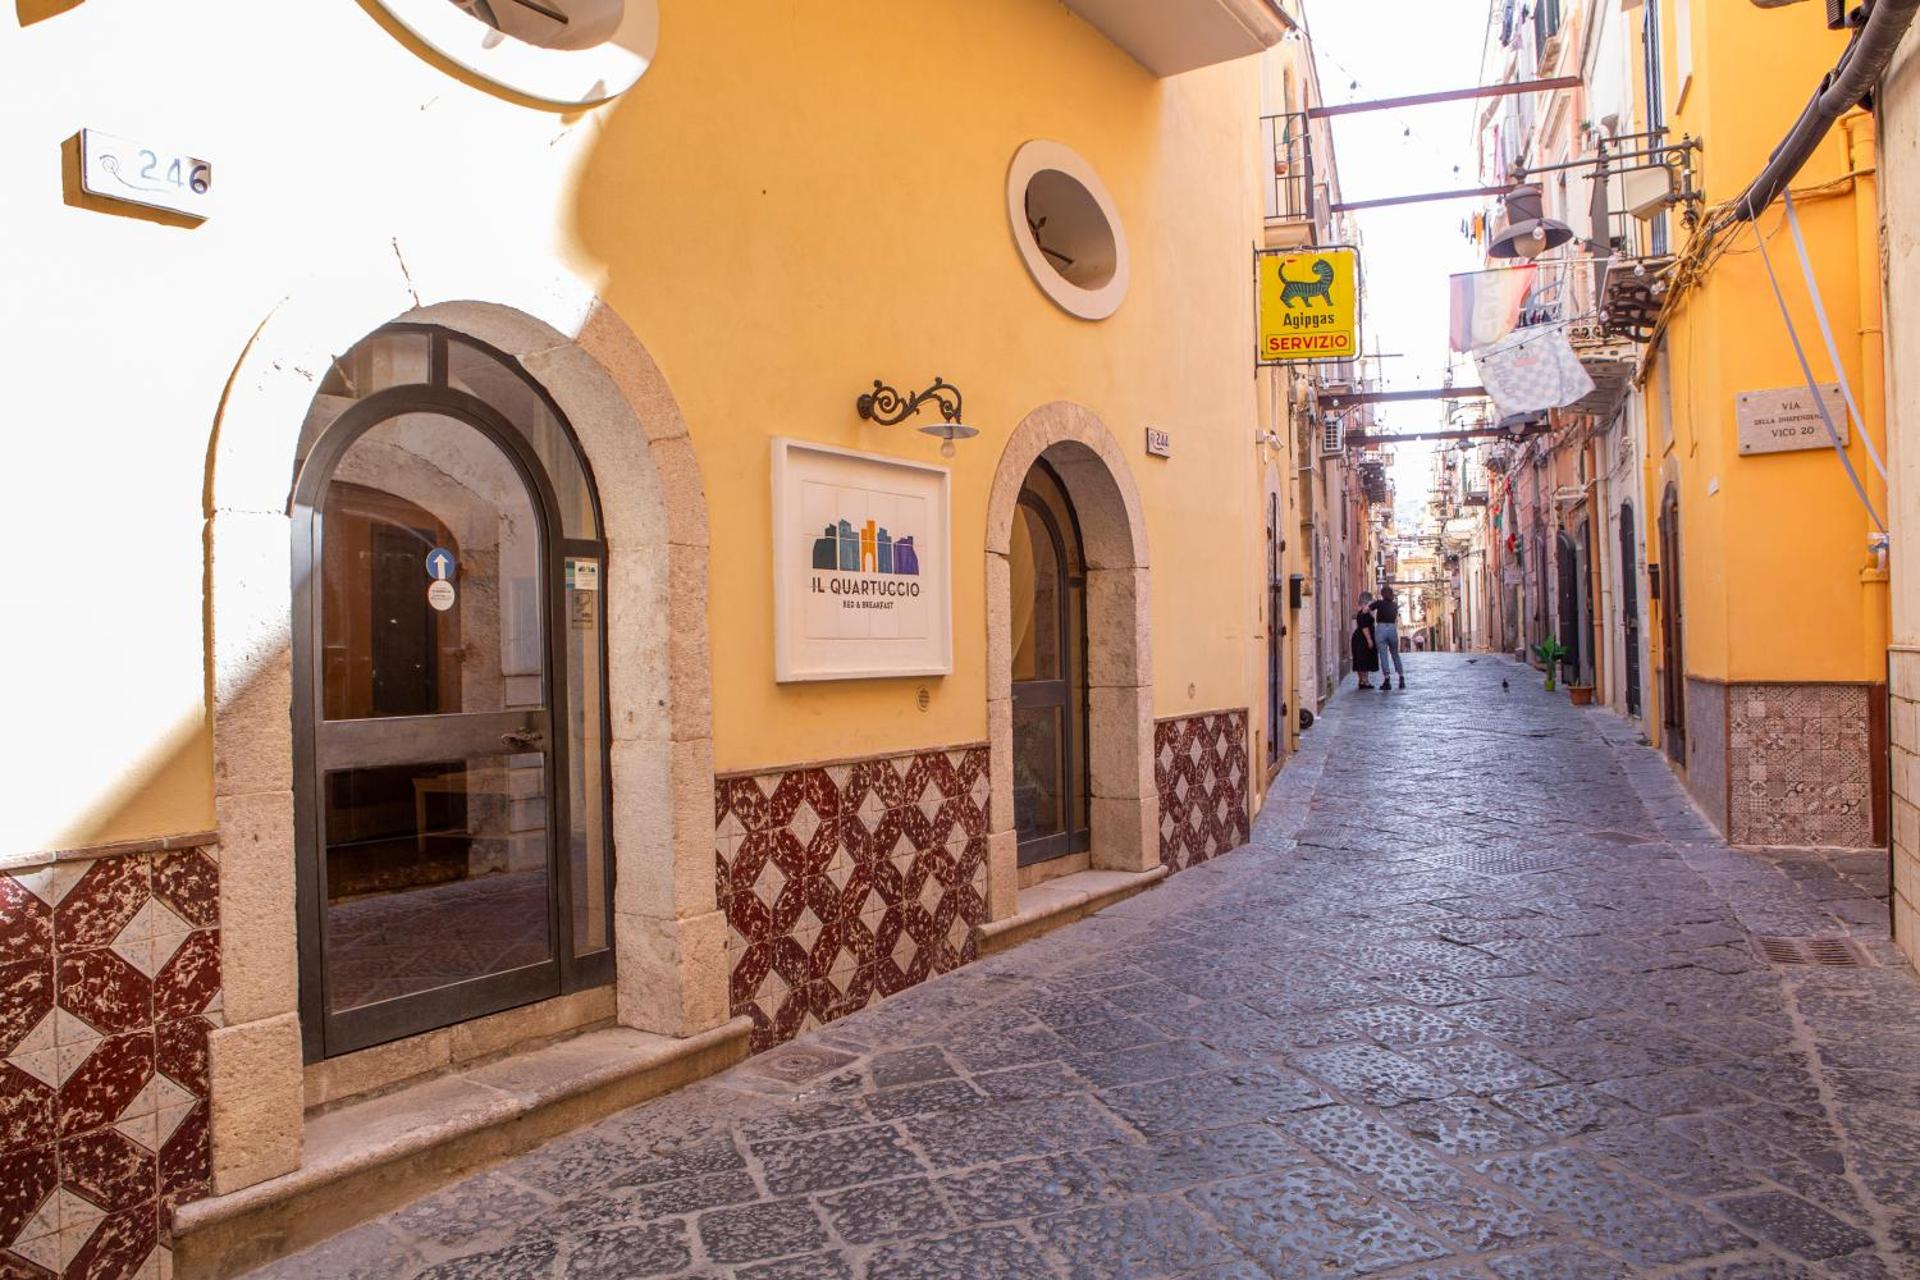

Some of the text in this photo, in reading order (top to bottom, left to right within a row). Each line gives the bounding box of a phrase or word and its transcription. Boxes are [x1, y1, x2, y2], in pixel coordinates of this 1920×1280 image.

[139, 149, 209, 195] 246
[1283, 312, 1335, 329] Agipgas
[1269, 335, 1348, 351] SERVIZIO
[1782, 401, 1800, 410] VIA
[1771, 426, 1815, 437] VICO 20
[812, 577, 920, 598] IL QUARTUCCIO
[842, 600, 894, 610] BED & BREAKFAST
